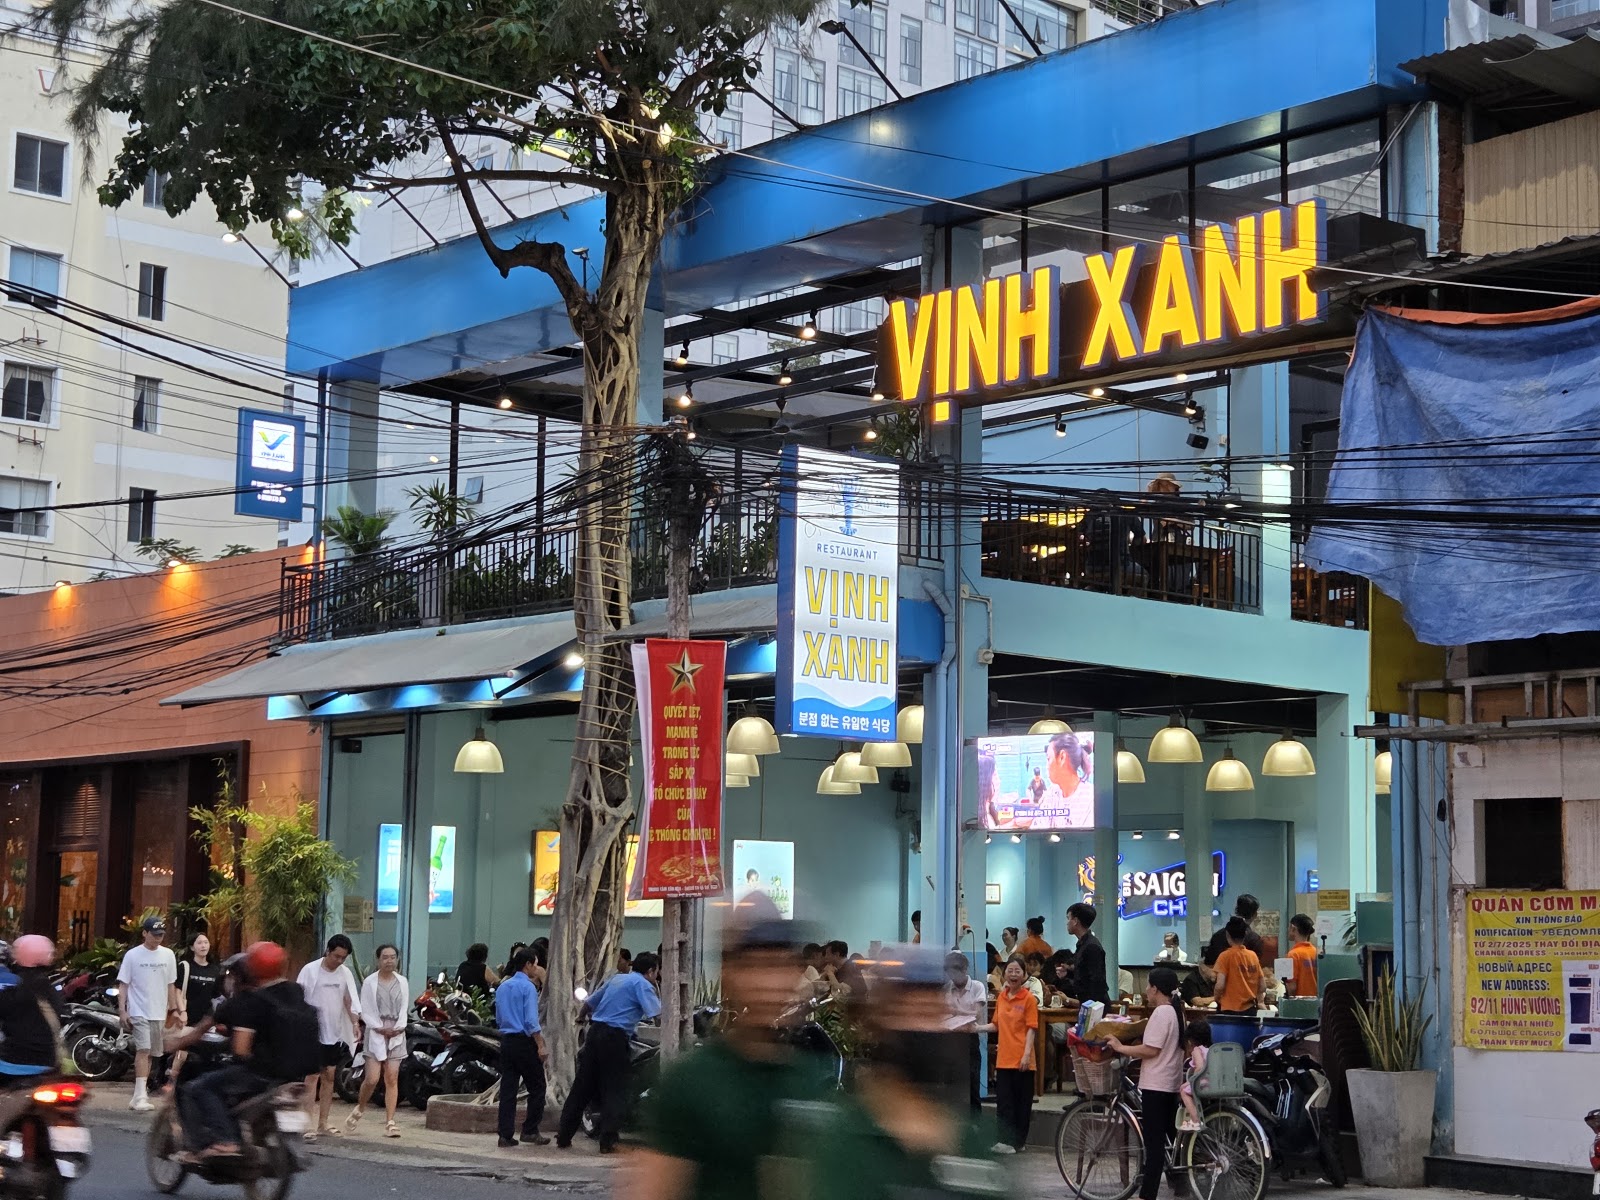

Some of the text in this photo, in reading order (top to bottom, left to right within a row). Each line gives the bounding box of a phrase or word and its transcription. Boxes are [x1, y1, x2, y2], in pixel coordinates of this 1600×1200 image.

[891, 199, 1319, 422] VỊNH XANH
[817, 543, 878, 560] RESTAURANT
[804, 566, 890, 628] VỊNH
[802, 630, 890, 684] XANH
[798, 711, 818, 727] 분점
[820, 713, 839, 729] 없는
[872, 718, 891, 733] 식당
[666, 726, 690, 741] MẠNH
[662, 746, 689, 759] TRONG
[669, 762, 684, 780] SẮP
[1122, 872, 1132, 897] BIA
[1133, 871, 1220, 897] SAIG
[1471, 895, 1600, 913] QUÁN CƠM M
[1515, 914, 1583, 924] XIN THÔNG BÁO
[1474, 928, 1533, 937] NOTIFICATION
[1478, 961, 1552, 974] НОВЫЙ АДРЕС
[1482, 979, 1550, 990] NEW ADDRESS:
[1470, 997, 1498, 1014] 92/11
[1501, 994, 1526, 1014] HÙNG
[1470, 1028, 1518, 1036] БОЛЬШОЕ
[1479, 1038, 1507, 1046] THANK
